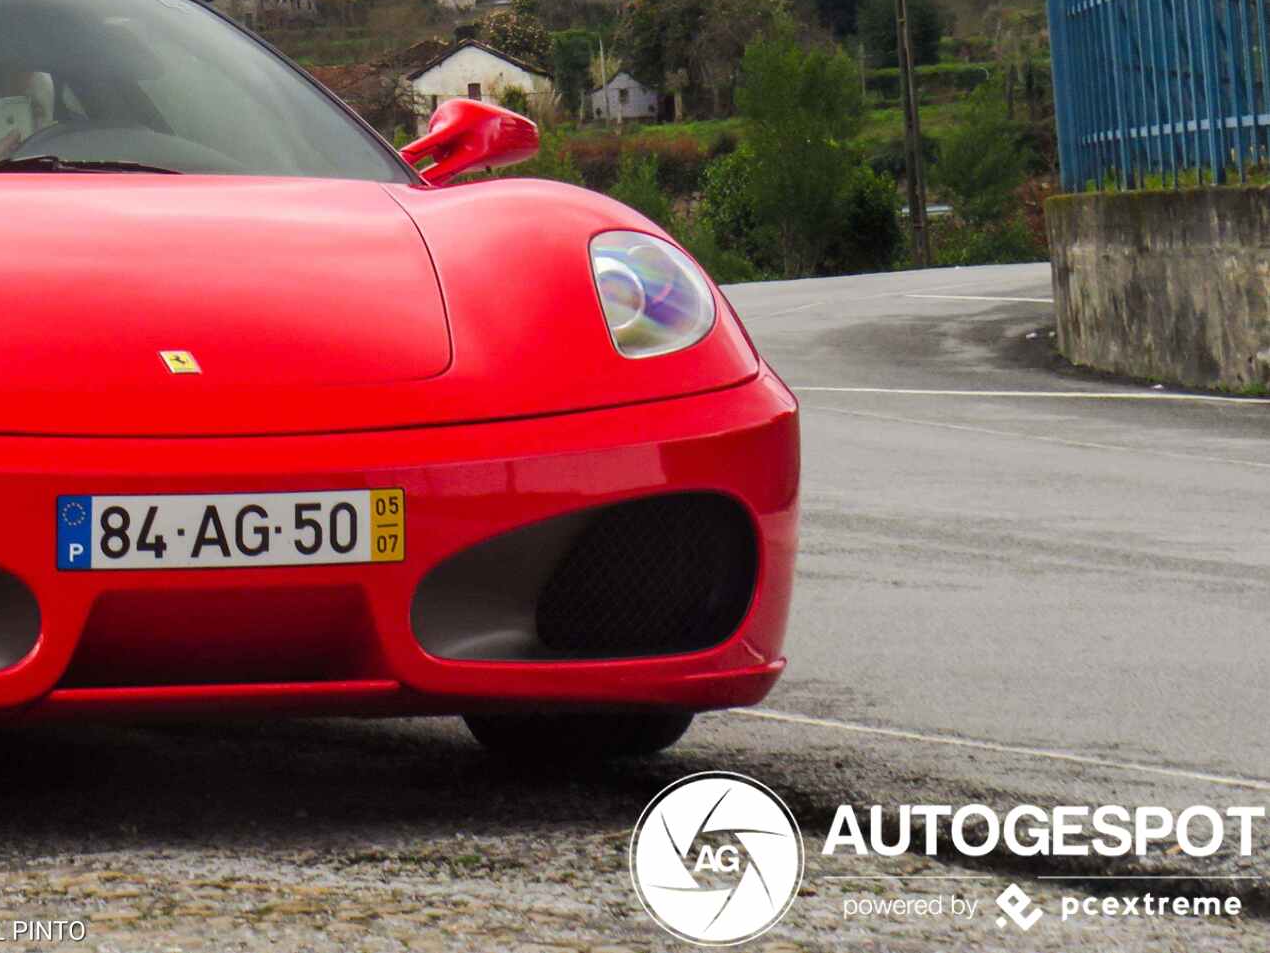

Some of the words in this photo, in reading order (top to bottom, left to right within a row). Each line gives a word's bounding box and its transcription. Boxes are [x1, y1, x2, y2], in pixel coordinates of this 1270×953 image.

[376, 496, 399, 516] 05
[69, 544, 84, 562] P
[377, 534, 399, 553] 07
